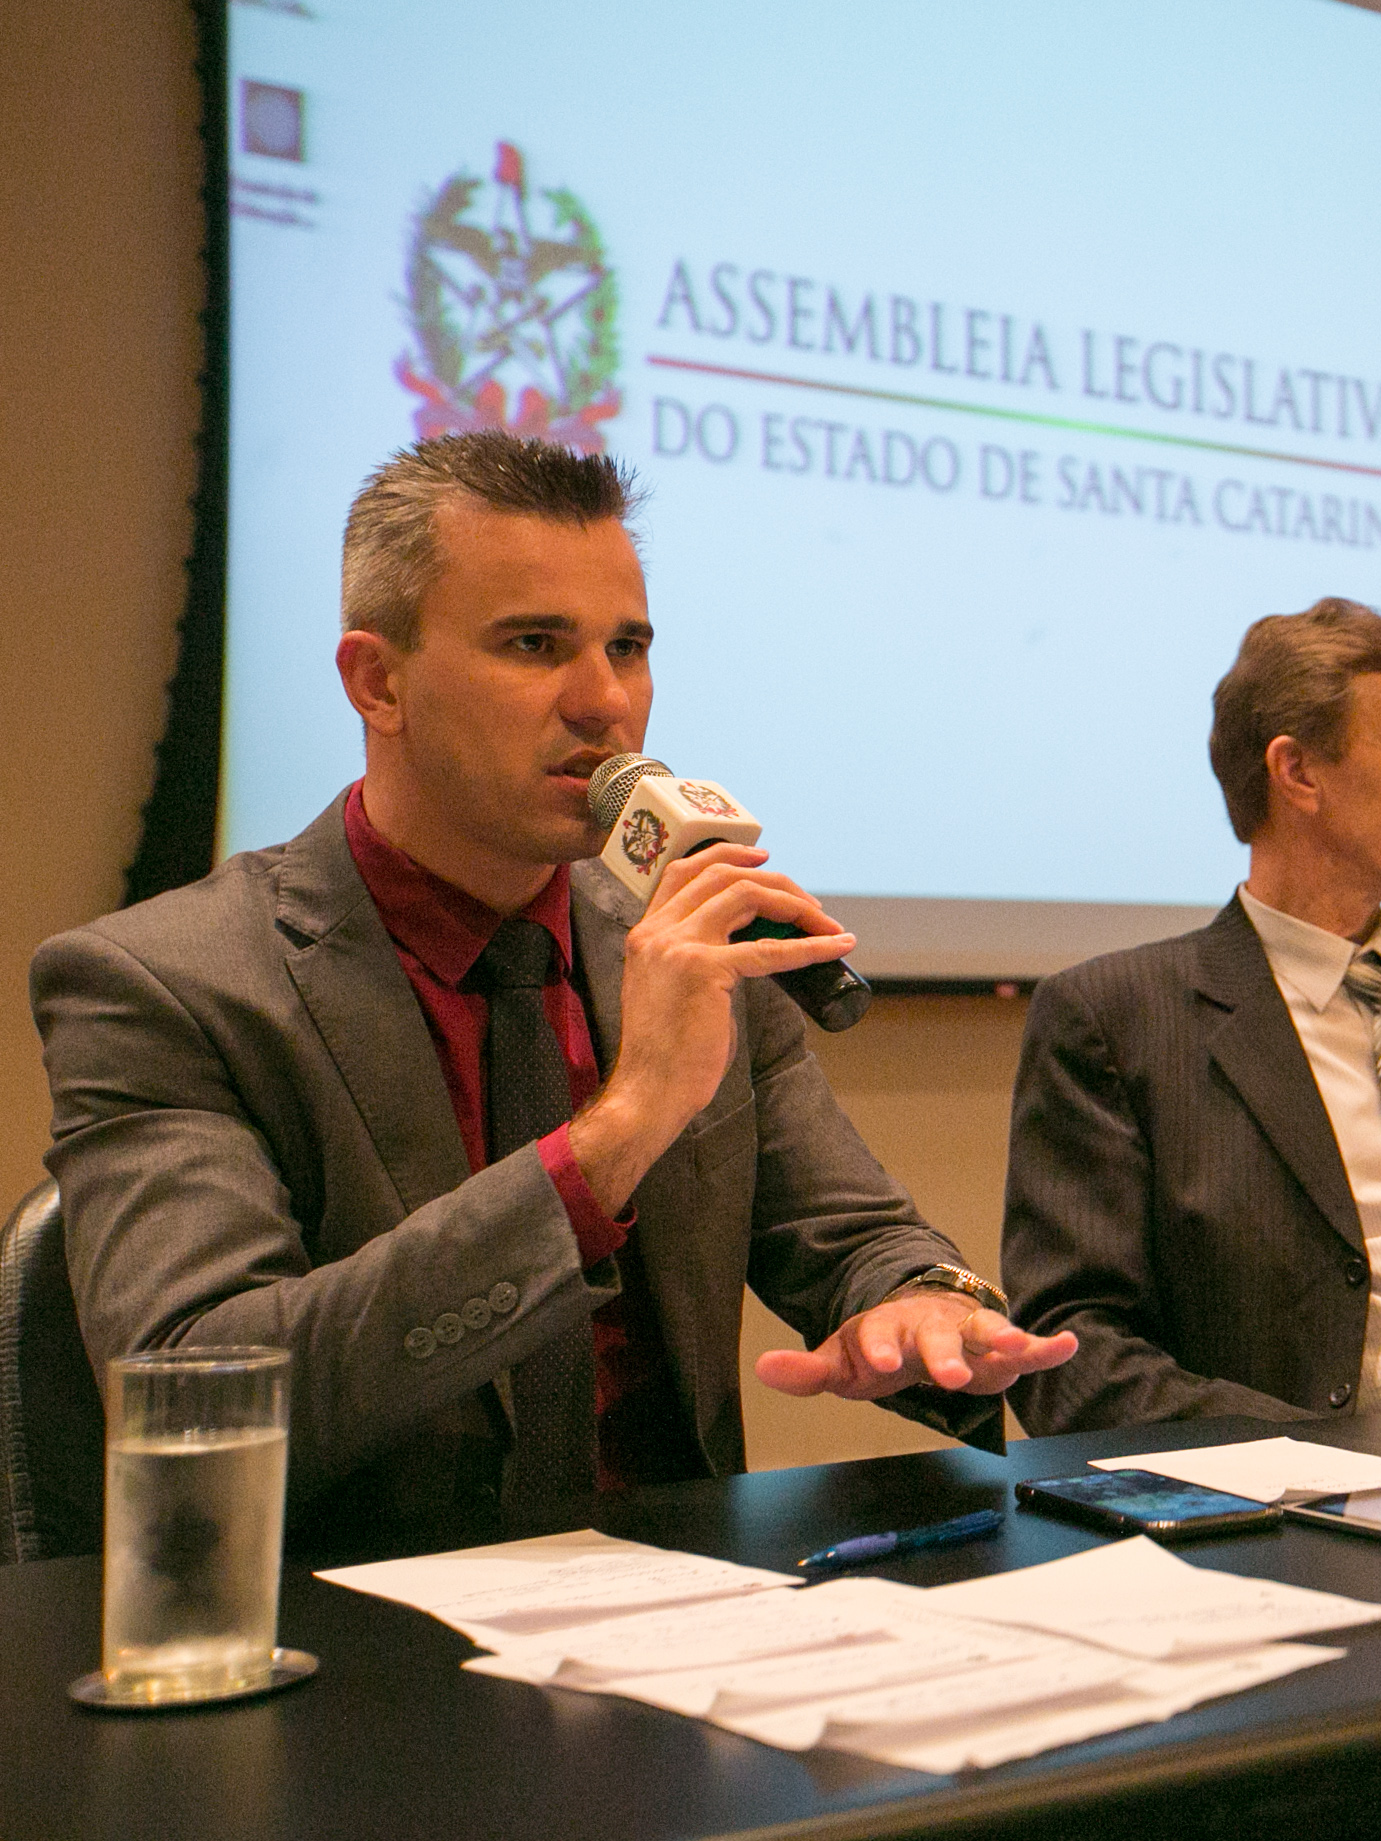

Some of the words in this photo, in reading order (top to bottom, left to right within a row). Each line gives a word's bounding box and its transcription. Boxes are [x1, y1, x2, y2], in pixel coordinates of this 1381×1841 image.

[656, 258, 1059, 393] ASSEMBLEIA
[651, 398, 739, 463] DO
[761, 413, 960, 492] ESTADO
[981, 445, 1040, 504] DE
[1057, 457, 1202, 526] SANTA
